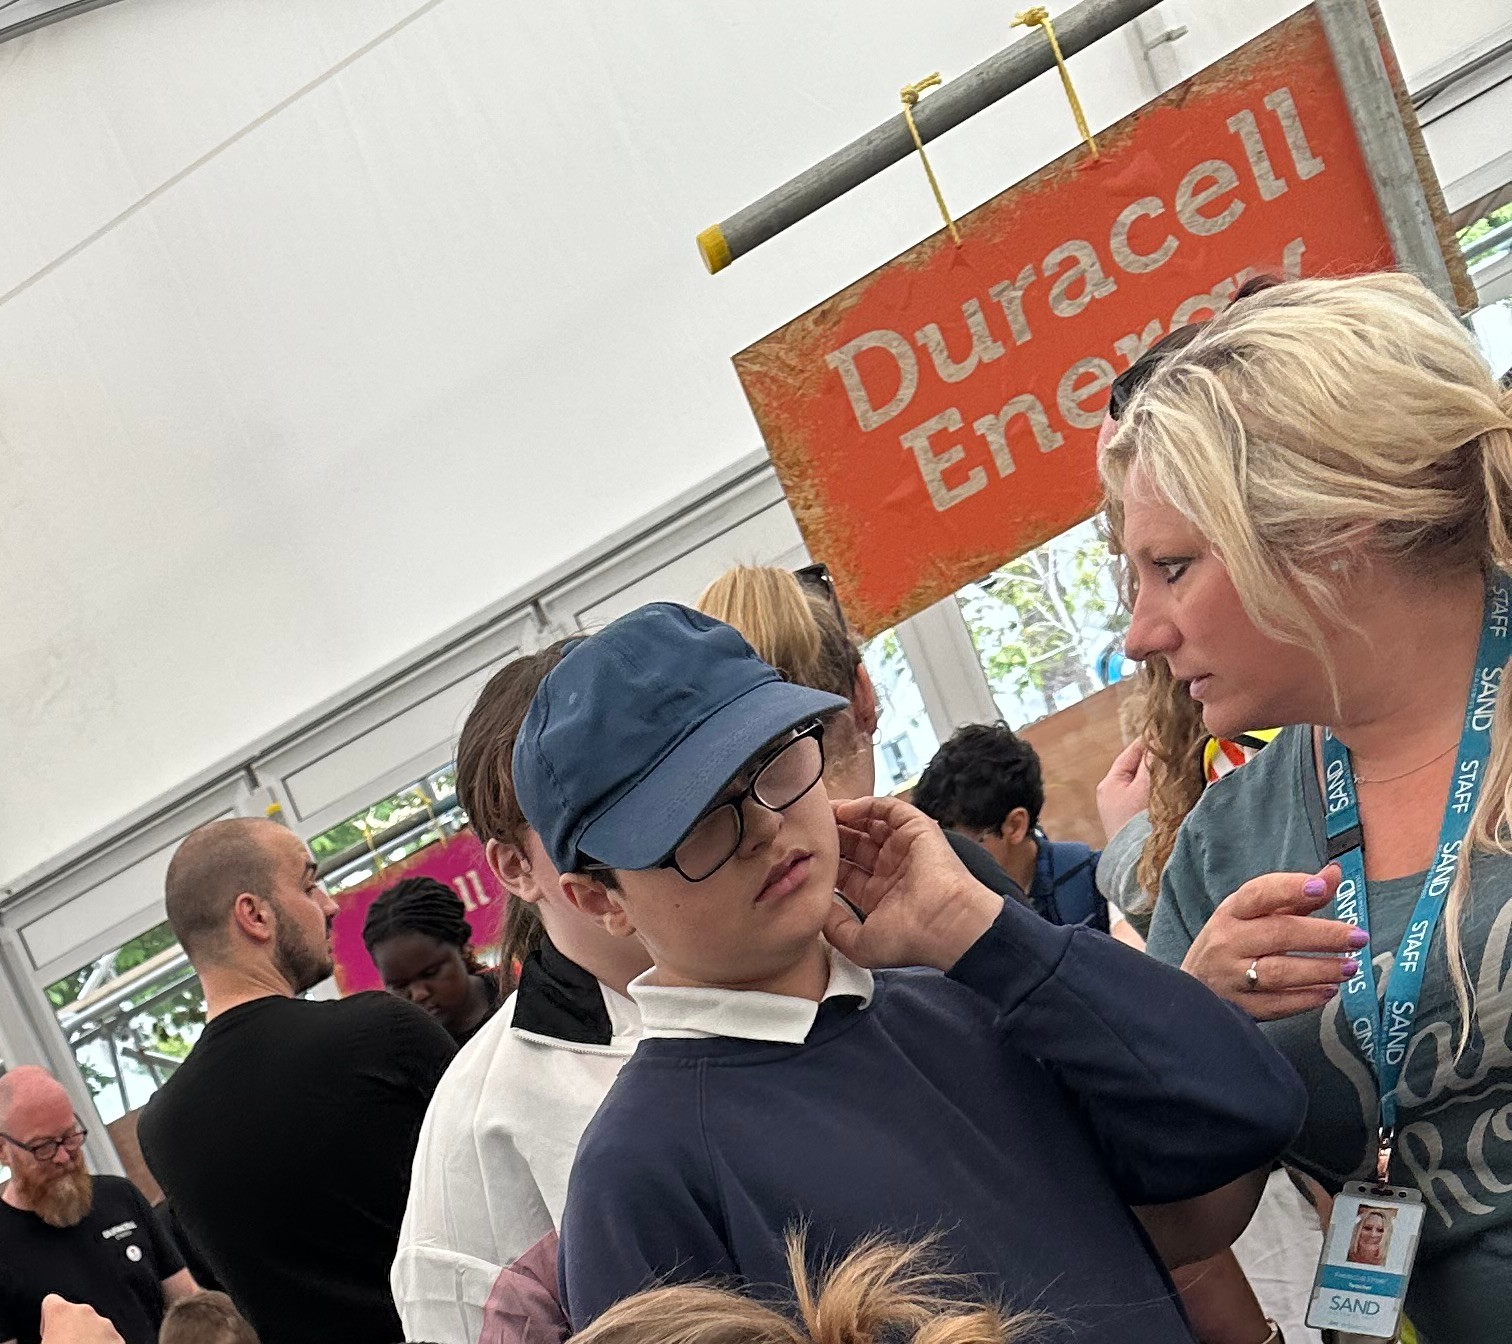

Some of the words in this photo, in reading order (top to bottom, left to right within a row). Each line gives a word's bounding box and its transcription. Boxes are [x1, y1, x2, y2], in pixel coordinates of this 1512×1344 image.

[825, 86, 1325, 433] Duracell
[1489, 585, 1509, 638] STAFF
[1471, 667, 1503, 732] SAND
[1326, 759, 1349, 814] SAND
[1451, 759, 1479, 815] STAFF
[1428, 839, 1463, 897] SAND
[1399, 919, 1429, 973] STAFF
[1385, 1000, 1415, 1065] SAND
[1329, 1294, 1380, 1316] SAND
